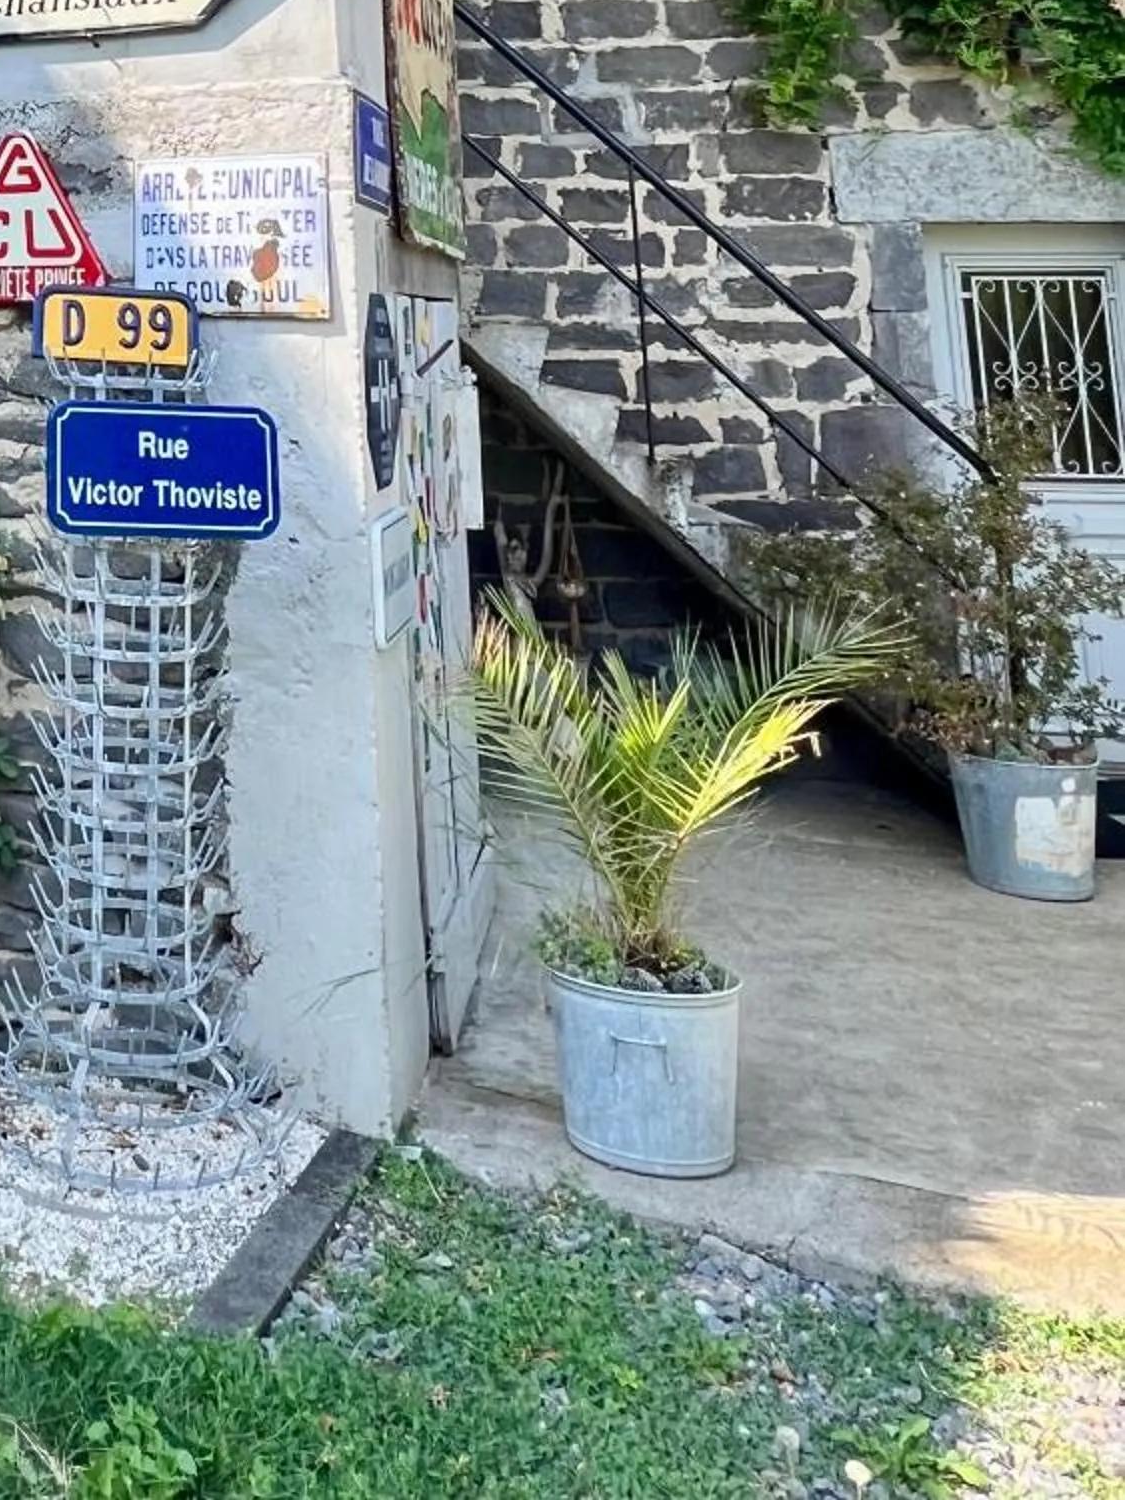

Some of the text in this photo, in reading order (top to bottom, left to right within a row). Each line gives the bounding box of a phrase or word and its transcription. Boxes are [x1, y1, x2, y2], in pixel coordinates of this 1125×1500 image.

[216, 216, 233, 235] DE
[189, 245, 208, 269] LA
[62, 300, 173, 351] D 99
[137, 431, 189, 459] Rue
[67, 476, 262, 511] Victor Thoviste
